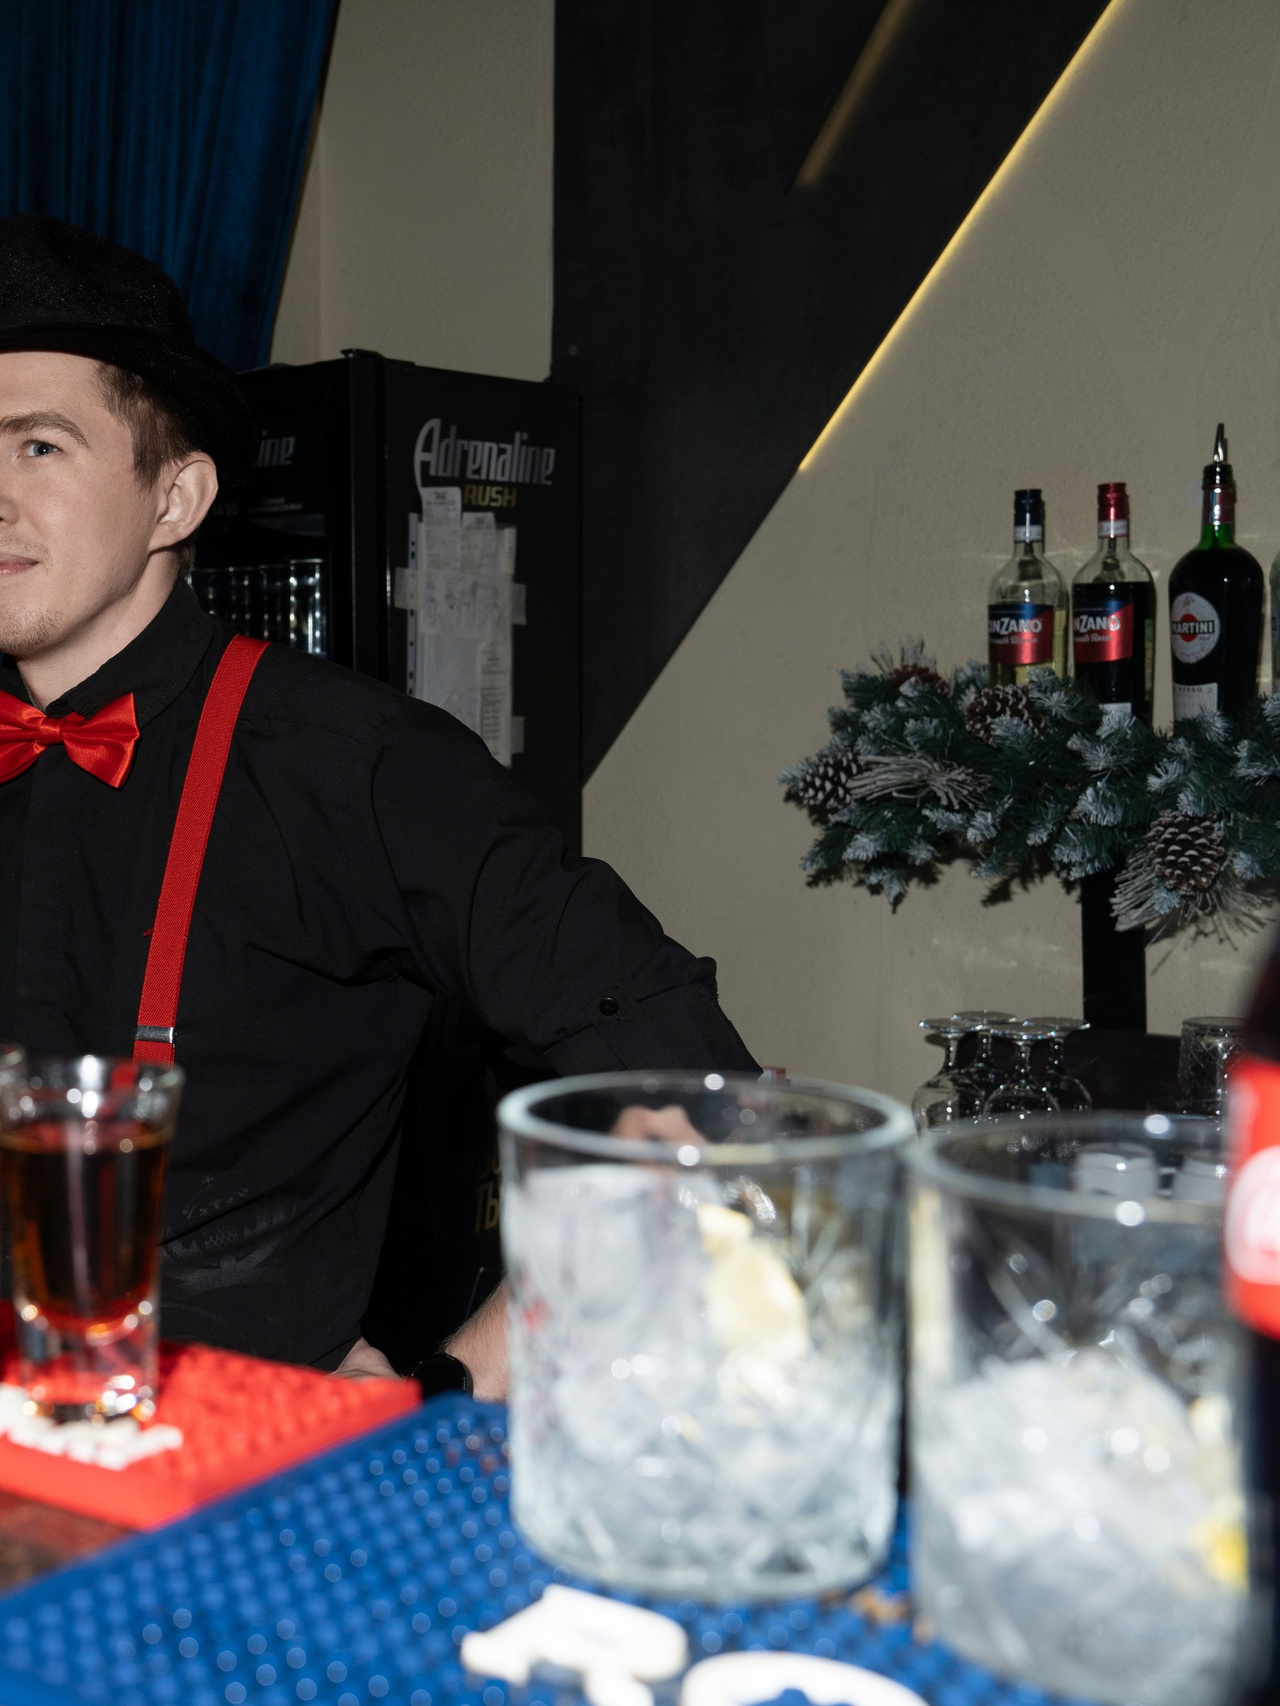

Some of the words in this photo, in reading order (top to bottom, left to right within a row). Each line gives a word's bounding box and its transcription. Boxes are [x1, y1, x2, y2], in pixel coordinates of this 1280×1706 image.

[413, 417, 557, 489] Adrenaline
[463, 483, 518, 509] RUSH
[988, 617, 1043, 636] INZANO
[1172, 621, 1214, 634] MARTINI
